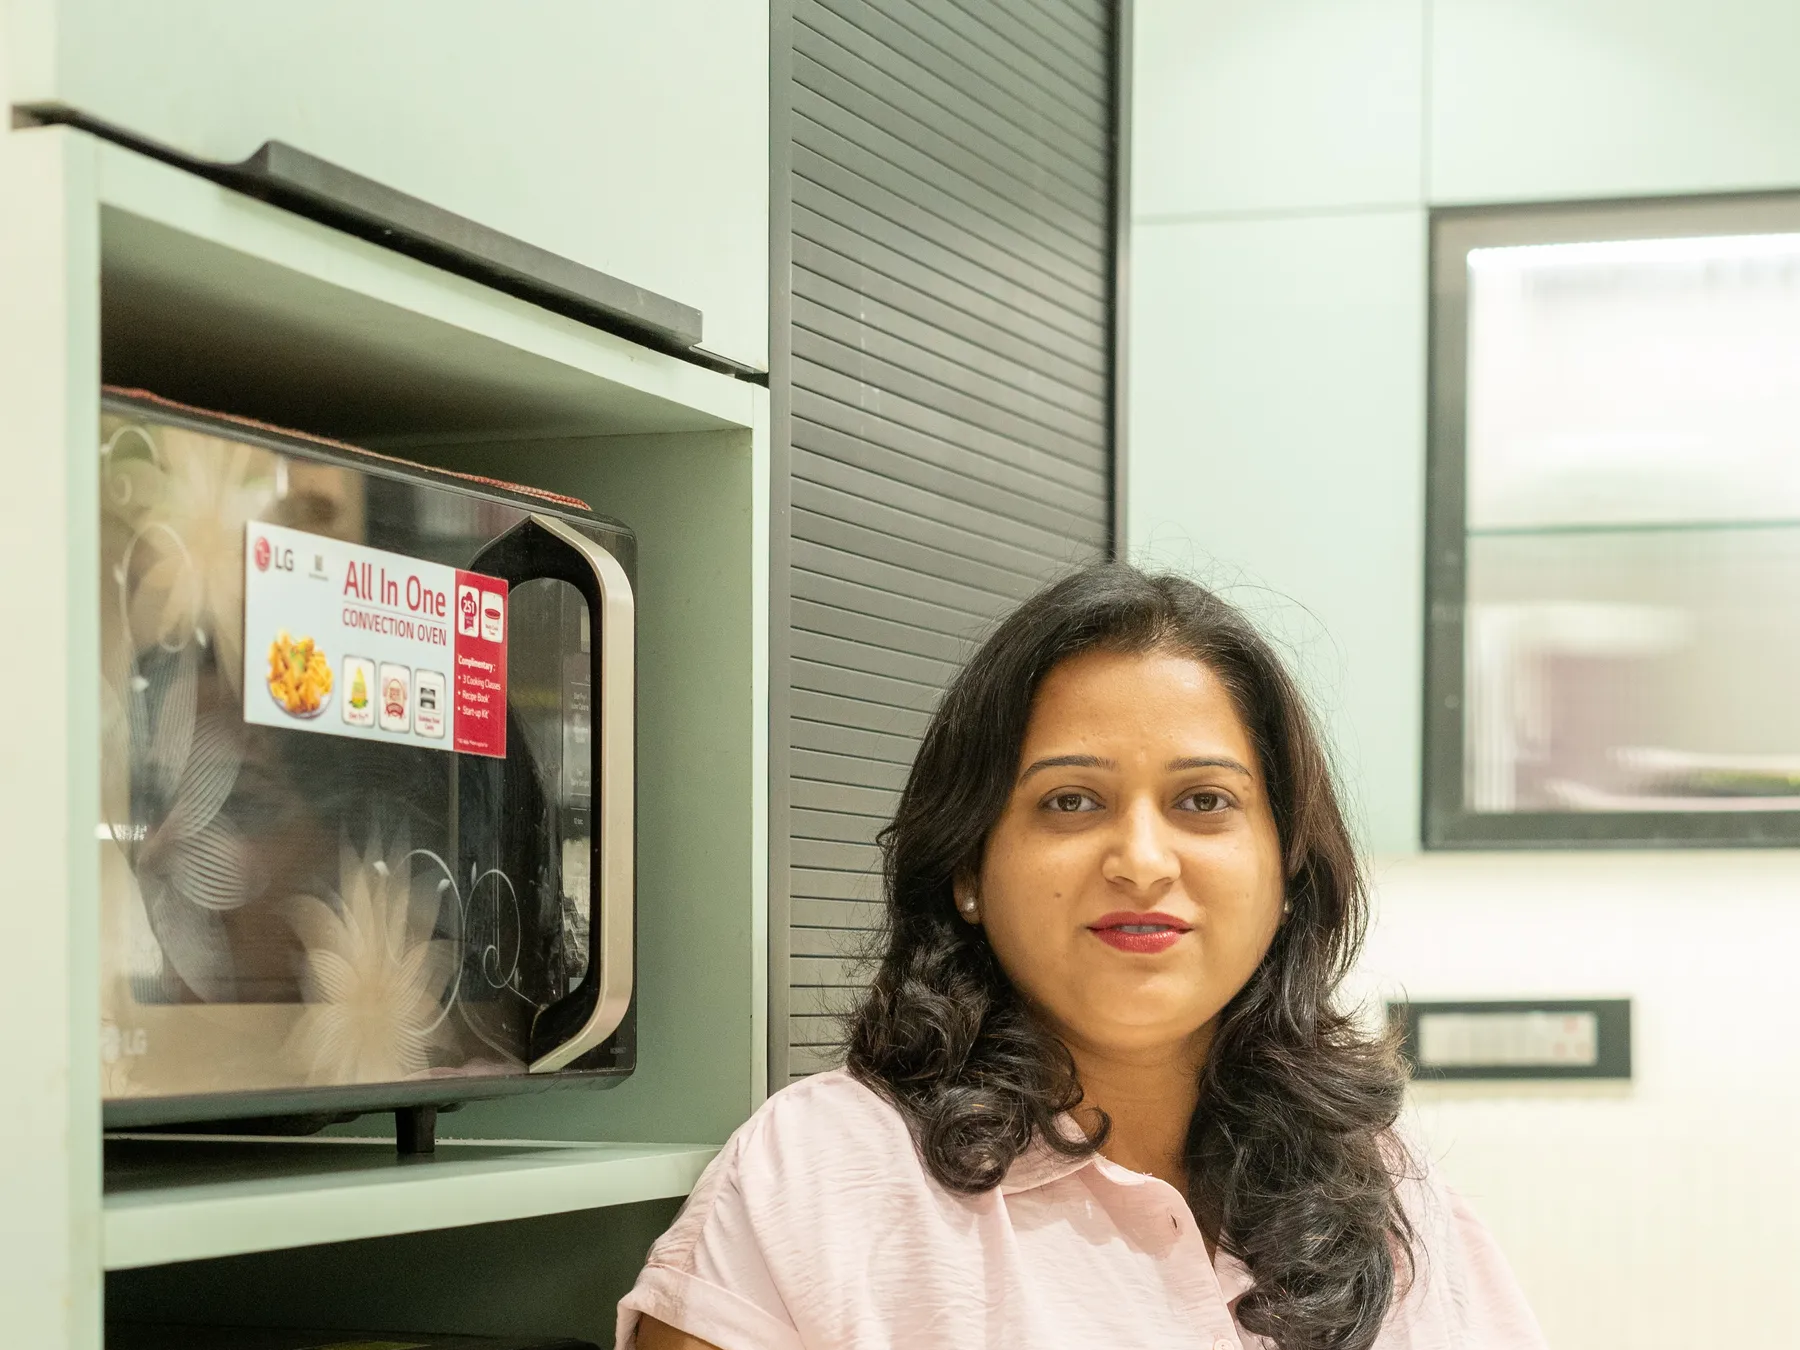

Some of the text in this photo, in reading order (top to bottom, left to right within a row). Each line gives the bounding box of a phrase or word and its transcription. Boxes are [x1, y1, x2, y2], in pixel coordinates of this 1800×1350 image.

[274, 545, 294, 572] LG
[343, 560, 446, 618] All In One
[342, 608, 447, 647] CONVECTION OVEN
[467, 675, 485, 690] Cooking
[484, 679, 501, 691] Classes
